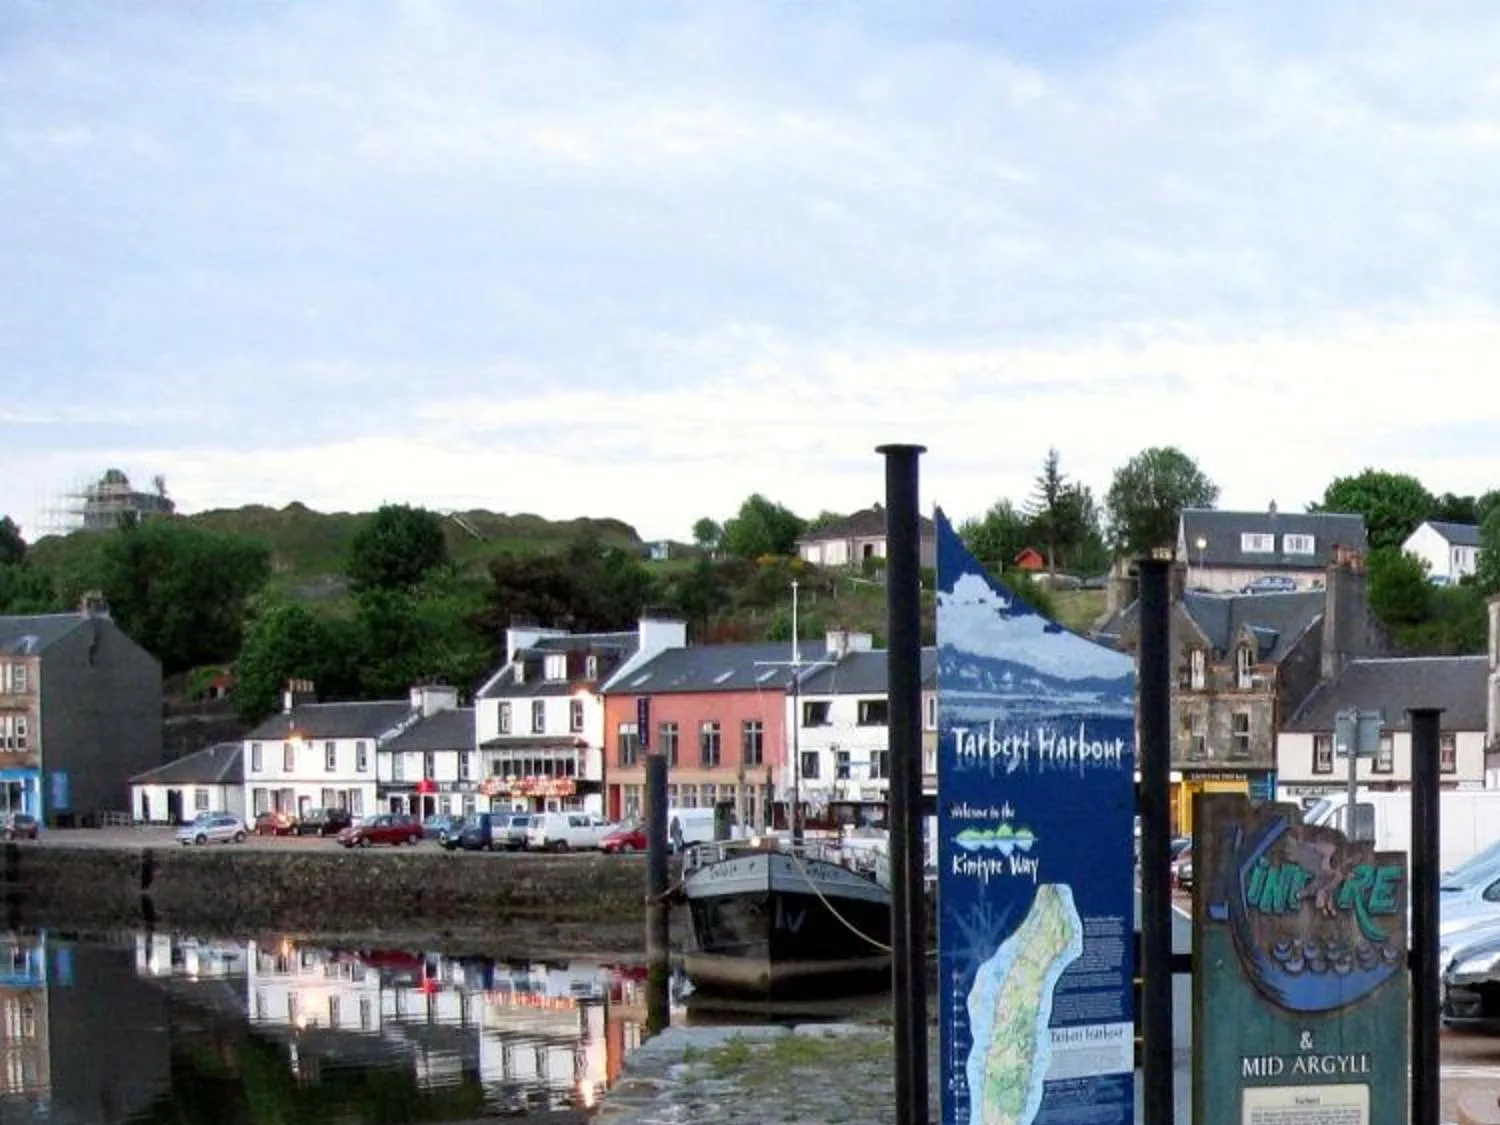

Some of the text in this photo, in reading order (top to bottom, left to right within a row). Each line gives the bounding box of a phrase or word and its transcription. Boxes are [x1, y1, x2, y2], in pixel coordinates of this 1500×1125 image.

[951, 717, 1124, 768] Tarbert Harbour
[953, 852, 1039, 885] Kintyre Way
[1300, 1031, 1313, 1049] &
[1242, 1055, 1370, 1076] MID ARGYLL
